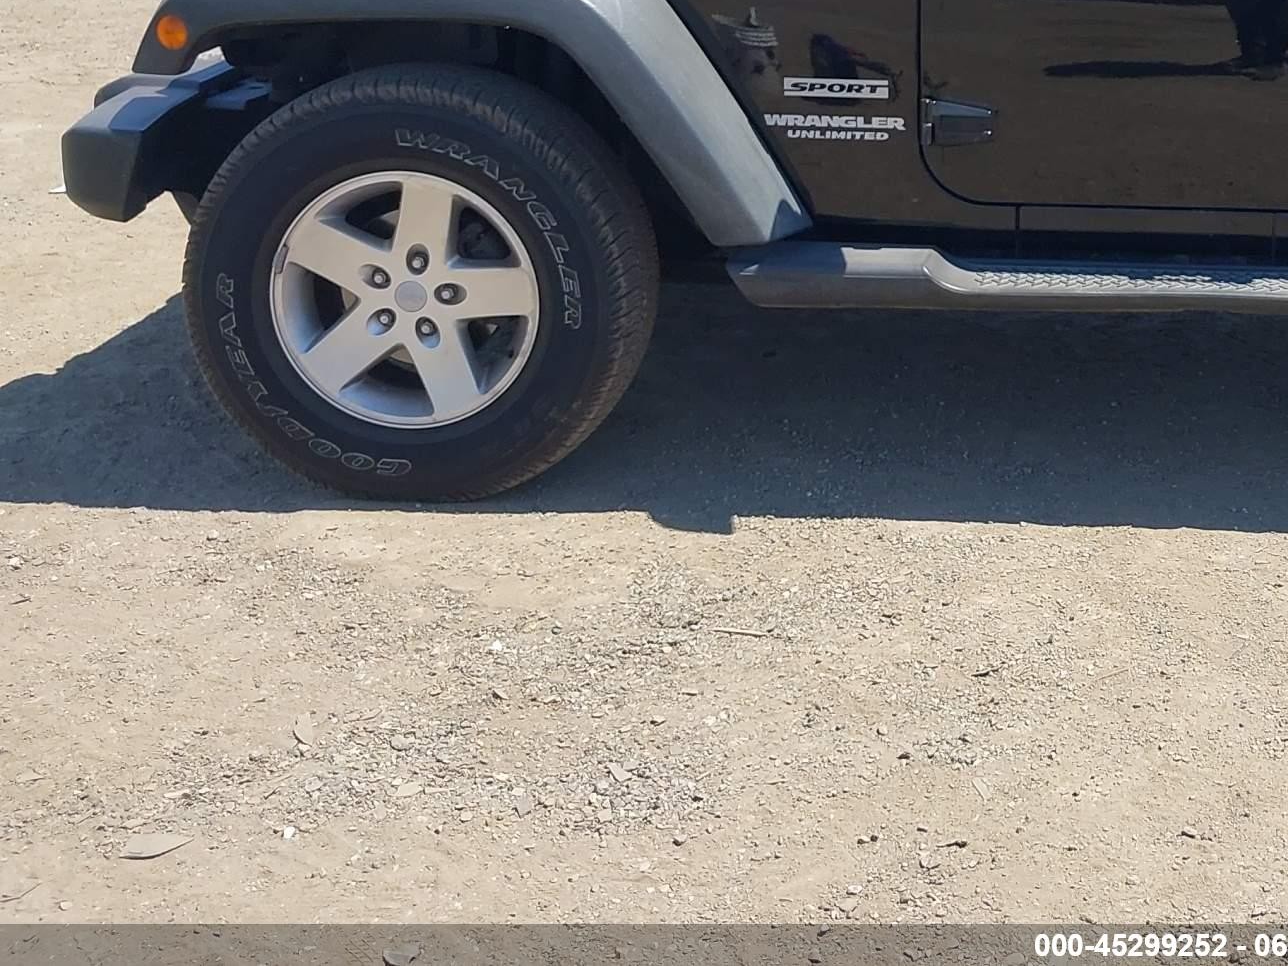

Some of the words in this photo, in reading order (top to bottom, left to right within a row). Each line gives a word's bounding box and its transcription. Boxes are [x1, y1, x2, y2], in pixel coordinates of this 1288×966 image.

[790, 81, 886, 95] SPORT
[763, 113, 906, 130] WRANGLER
[787, 130, 889, 141] UNLIMITED
[394, 128, 582, 330] WRANGLER
[215, 272, 413, 476] GOODYEAR
